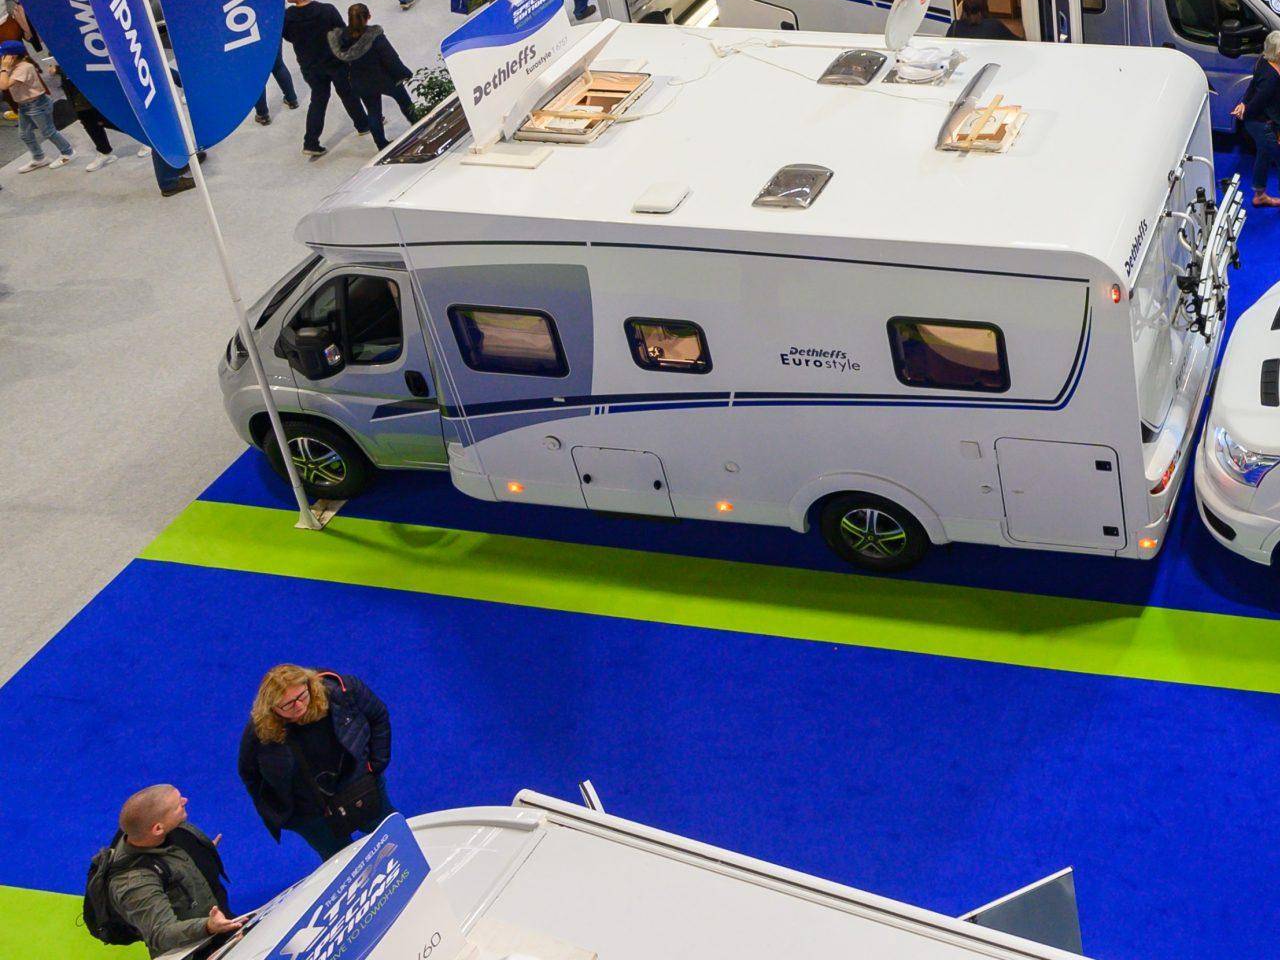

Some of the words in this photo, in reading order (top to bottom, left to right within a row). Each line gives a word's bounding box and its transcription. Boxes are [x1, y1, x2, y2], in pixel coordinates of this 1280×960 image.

[473, 44, 537, 106] Dethleffs
[525, 51, 552, 75] Eurostyle
[1124, 218, 1148, 278] Dethleffs
[780, 354, 861, 374] Eurostyle
[788, 346, 847, 360] Dethleffs
[325, 895, 338, 908] THE
[338, 878, 352, 894] UK'S
[351, 861, 365, 879] BEST
[364, 833, 389, 861] SELLING
[348, 928, 360, 944] TO
[360, 869, 410, 930] LOWDHAMS
